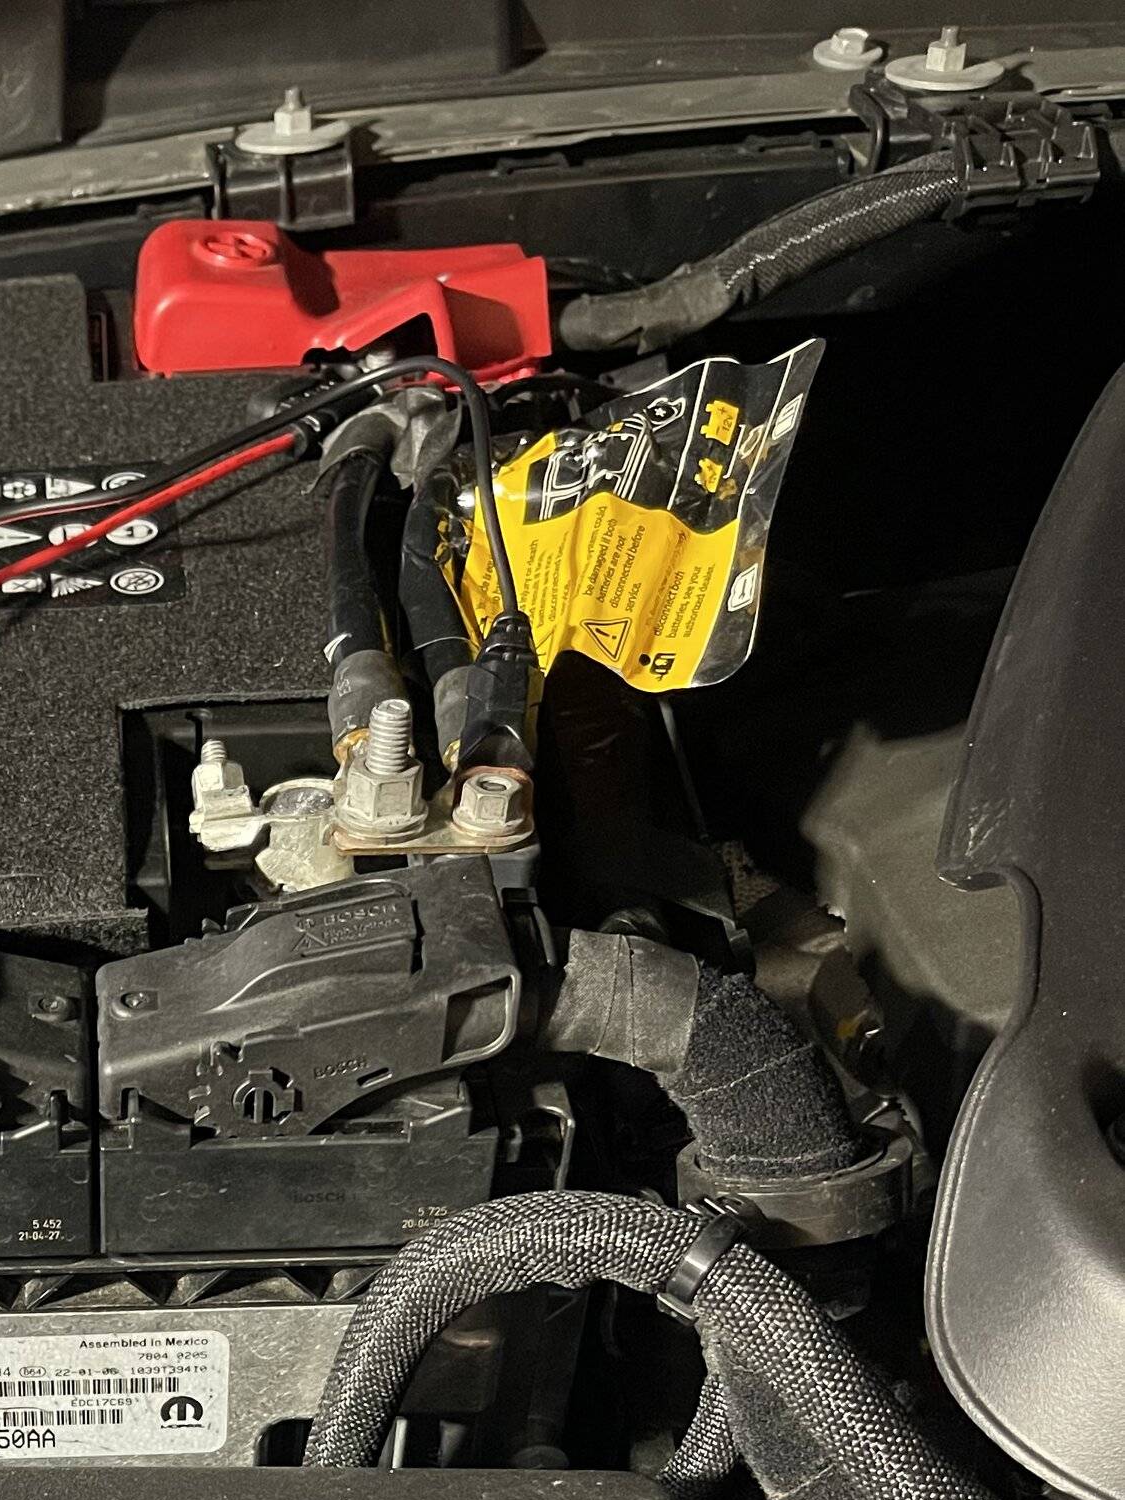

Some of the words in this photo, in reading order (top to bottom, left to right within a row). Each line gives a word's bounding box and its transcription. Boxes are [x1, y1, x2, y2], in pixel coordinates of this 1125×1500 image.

[582, 584, 594, 596] be
[588, 544, 608, 583] damaged
[603, 518, 616, 537] both
[614, 534, 626, 551] not
[608, 553, 635, 609] disconnected
[627, 526, 645, 553] before
[610, 552, 620, 567] are
[595, 566, 614, 603] batteries
[623, 582, 642, 612] service.
[652, 591, 676, 636] disconnect
[669, 571, 684, 591] both
[32, 1219, 40, 1229] 5
[42, 1219, 62, 1229] 452
[79, 1338, 147, 1349] Assembled
[150, 1338, 162, 1347] in
[165, 1337, 209, 1347] Mexico
